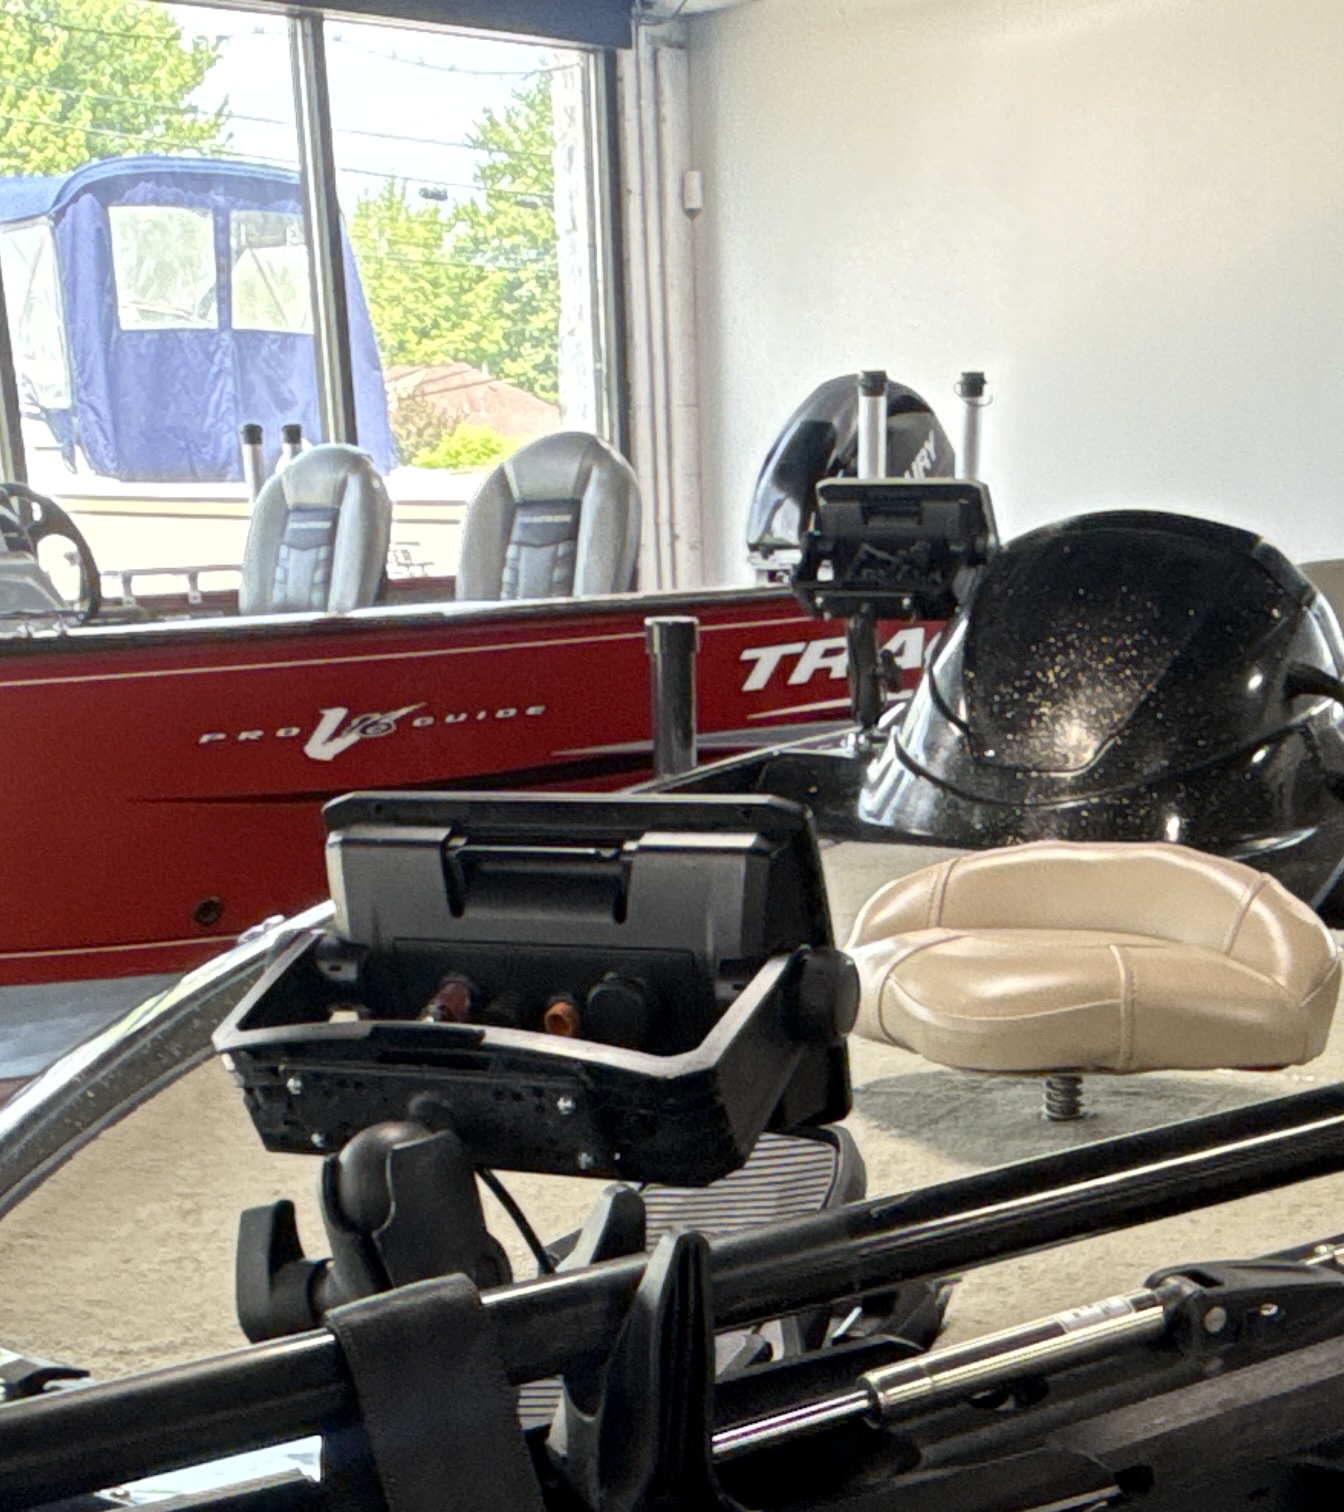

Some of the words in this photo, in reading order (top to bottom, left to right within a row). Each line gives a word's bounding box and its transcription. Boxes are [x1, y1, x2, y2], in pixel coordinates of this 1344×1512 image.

[739, 627, 943, 692] TRA
[198, 726, 302, 745] PRO
[411, 704, 547, 728] GUIDE
